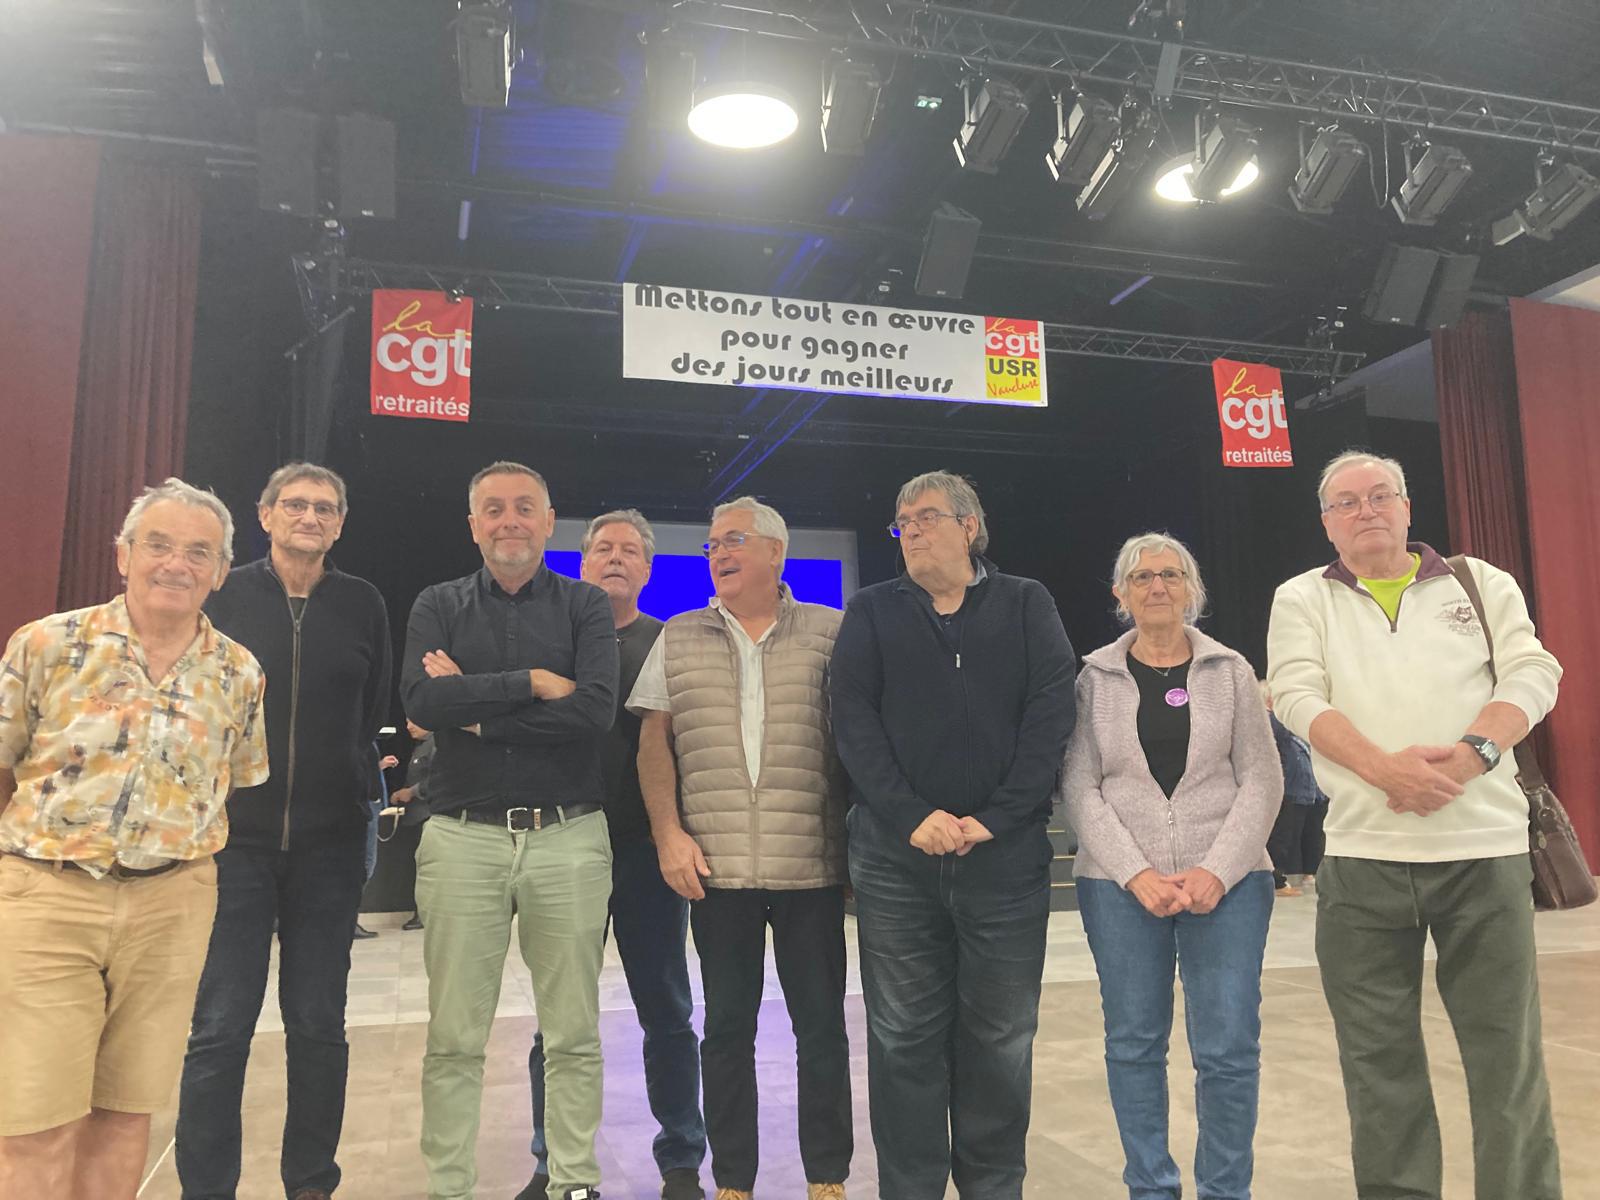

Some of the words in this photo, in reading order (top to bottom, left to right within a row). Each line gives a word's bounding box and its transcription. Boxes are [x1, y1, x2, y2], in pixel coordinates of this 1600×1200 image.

[635, 284, 762, 316] Mettons
[772, 297, 832, 323] tout
[842, 309, 877, 327] en
[888, 313, 975, 335] œuvre
[376, 329, 471, 386] cgt
[721, 330, 791, 351] pour
[801, 336, 908, 363] gagner
[985, 331, 1040, 357] cgt
[671, 352, 725, 377] des
[732, 356, 810, 385] jours
[821, 366, 953, 394] meilleurs
[988, 358, 1037, 377] USR
[986, 377, 1039, 396] Vaucluse
[375, 394, 470, 417] retraités
[1221, 389, 1288, 439] cgt
[1225, 446, 1292, 463] retraités
